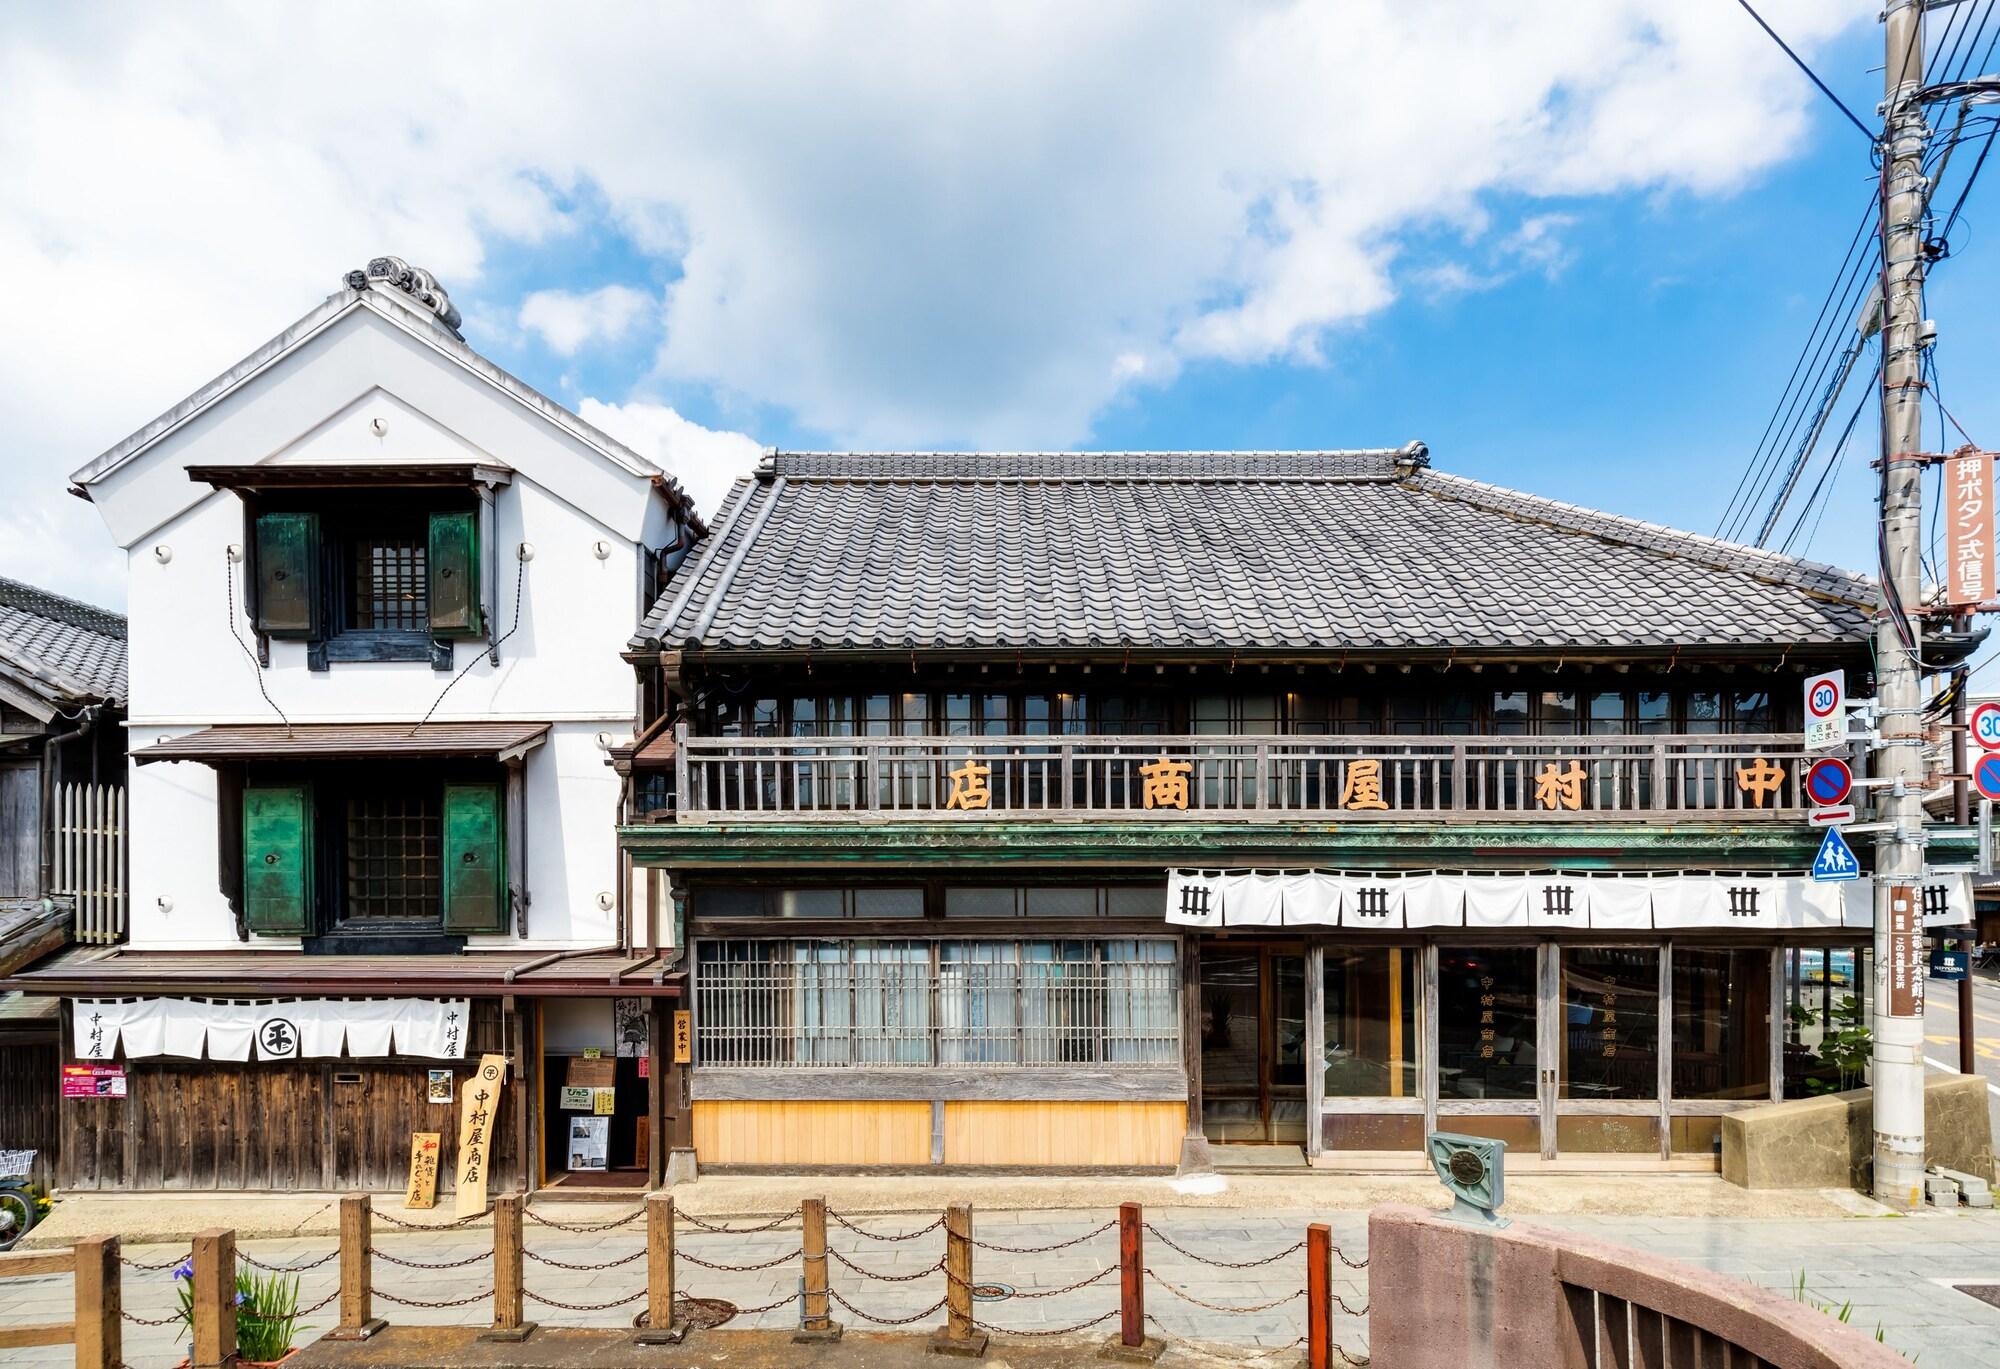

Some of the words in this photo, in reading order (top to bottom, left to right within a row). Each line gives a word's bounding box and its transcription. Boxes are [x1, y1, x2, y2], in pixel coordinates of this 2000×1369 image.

[1957, 459, 1984, 601] 押ボタン式信号
[1815, 689, 1832, 708] 30
[1810, 730, 1839, 743] ここまで
[1816, 722, 1833, 733] 区域
[88, 1012, 104, 1058] 中村屋
[443, 1011, 459, 1057] 中村屋
[677, 1019, 687, 1055] 営業中
[462, 1088, 490, 1185] 中村屋商店
